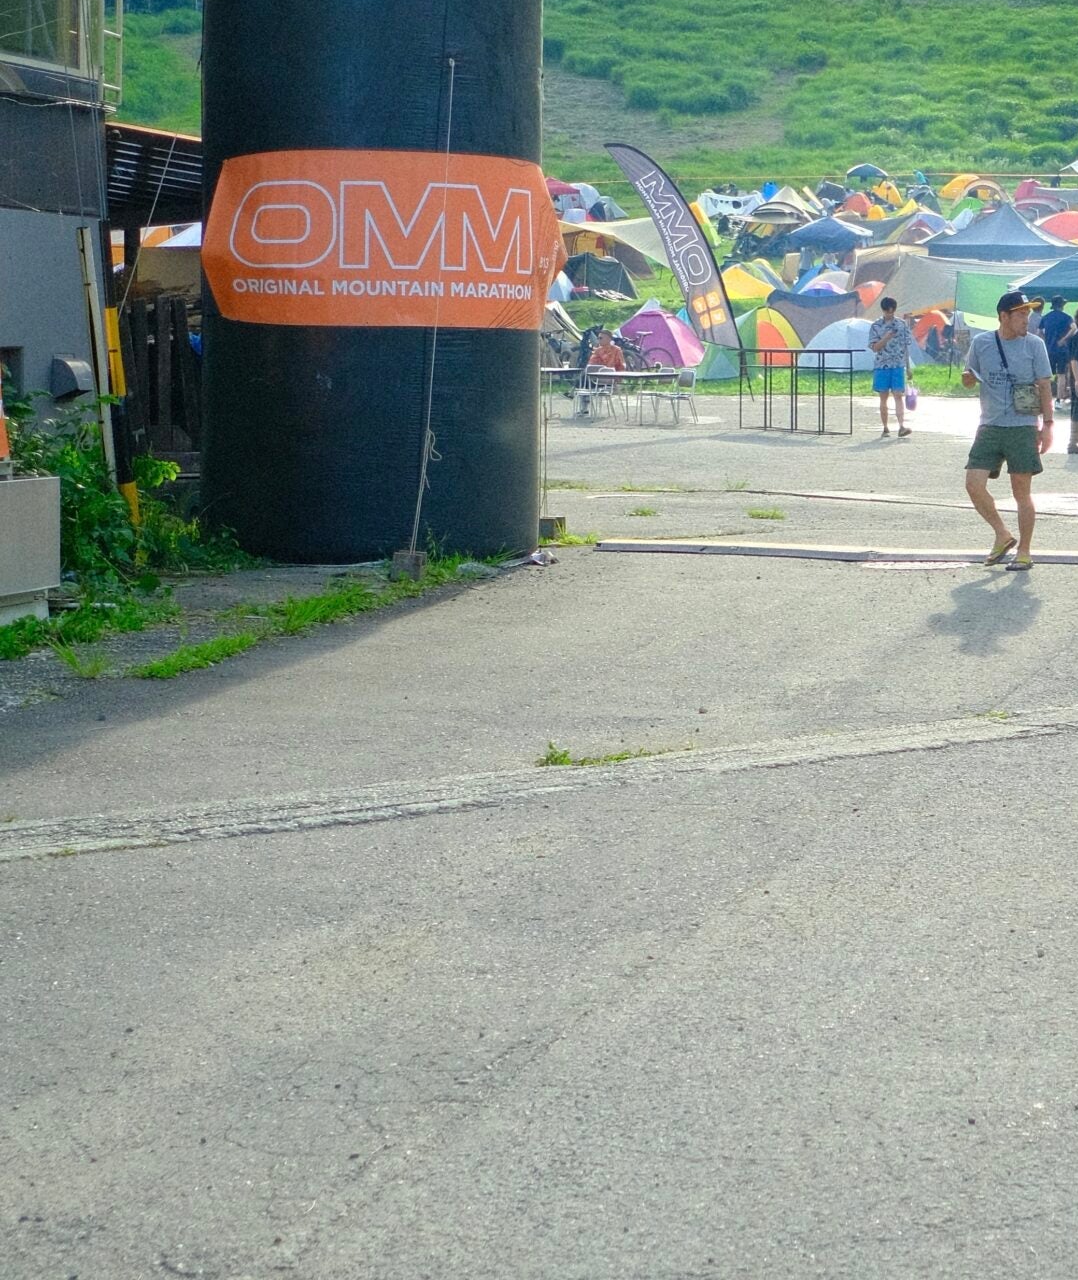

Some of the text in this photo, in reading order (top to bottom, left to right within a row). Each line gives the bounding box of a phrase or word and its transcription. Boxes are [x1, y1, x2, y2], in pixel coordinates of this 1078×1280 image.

[229, 179, 533, 276] OMM
[232, 278, 532, 301] ORIGINAL MOUNTAIN MARATHON
